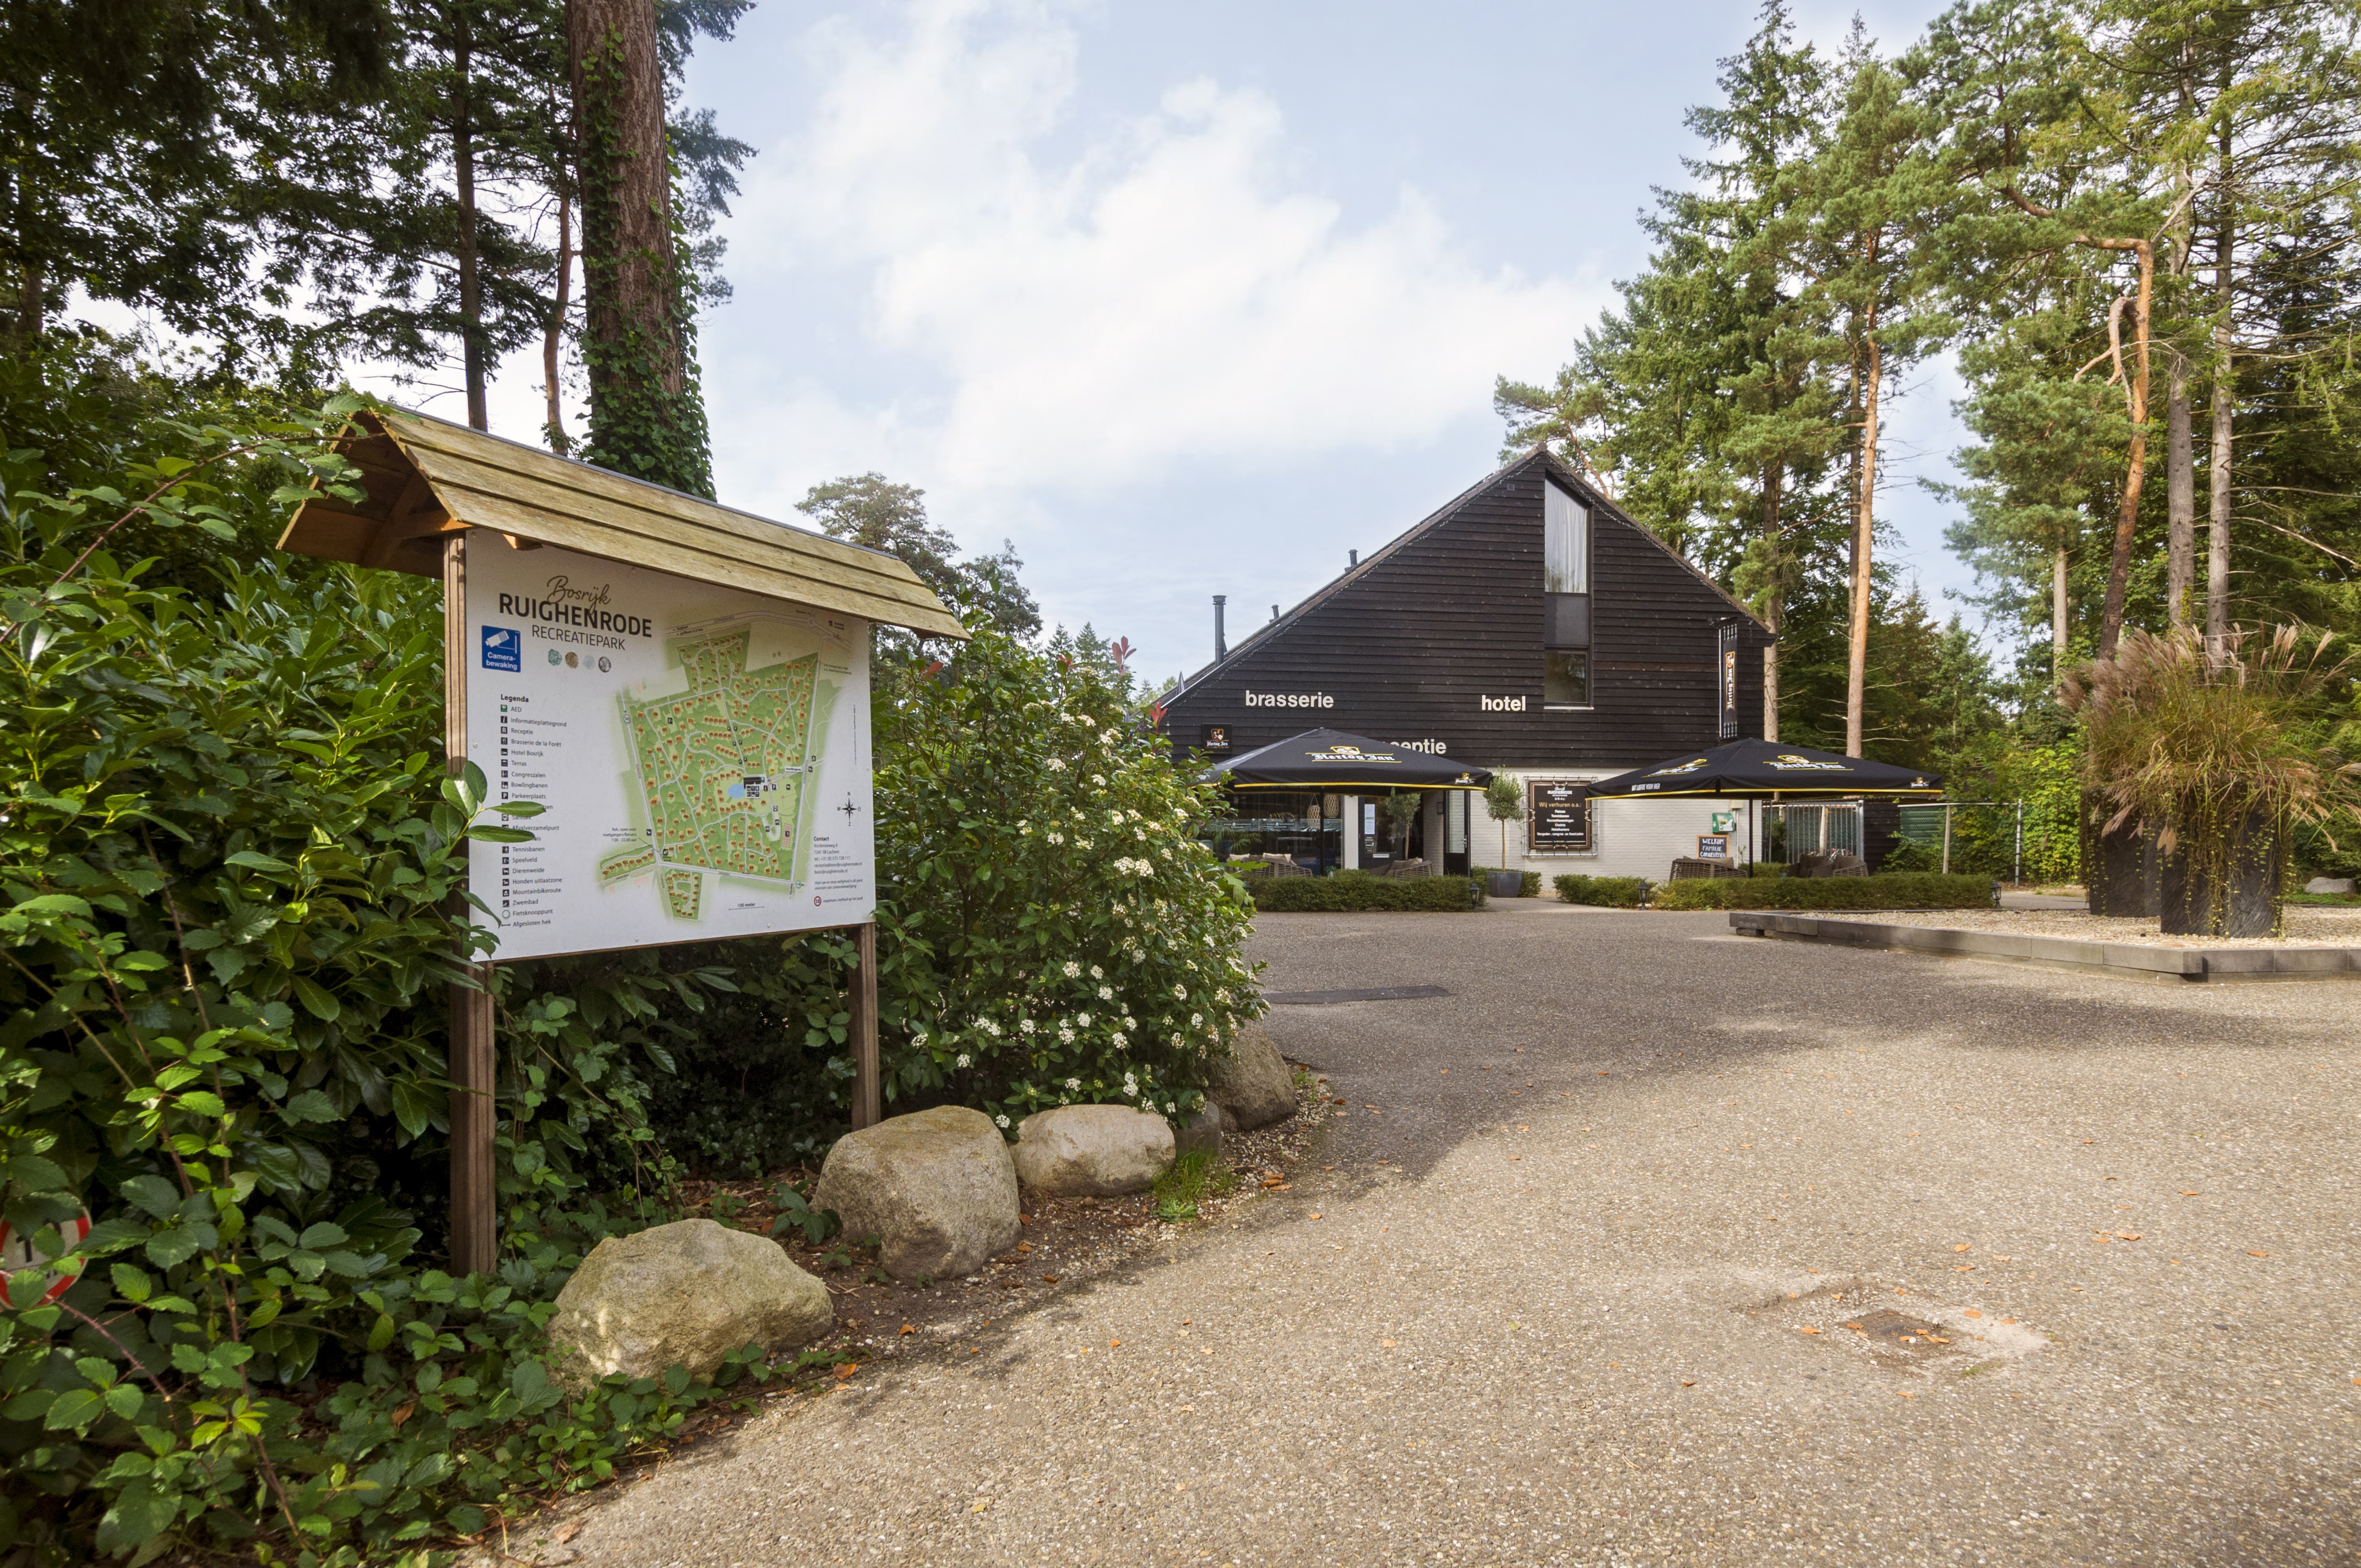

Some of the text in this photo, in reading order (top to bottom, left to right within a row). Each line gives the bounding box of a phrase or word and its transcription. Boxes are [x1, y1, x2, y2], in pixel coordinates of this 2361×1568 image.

[499, 593, 652, 638] RUIGHENRODE
[532, 625, 625, 651] RECREATIEPARK
[487, 652, 516, 661] Camera-
[486, 660, 518, 671] bewaking
[501, 694, 529, 703] Legenda
[1245, 690, 1334, 708] brasserie
[1482, 694, 1526, 711] hotel
[511, 717, 567, 727] Informatieplattegrond
[1383, 739, 1446, 754] eptie
